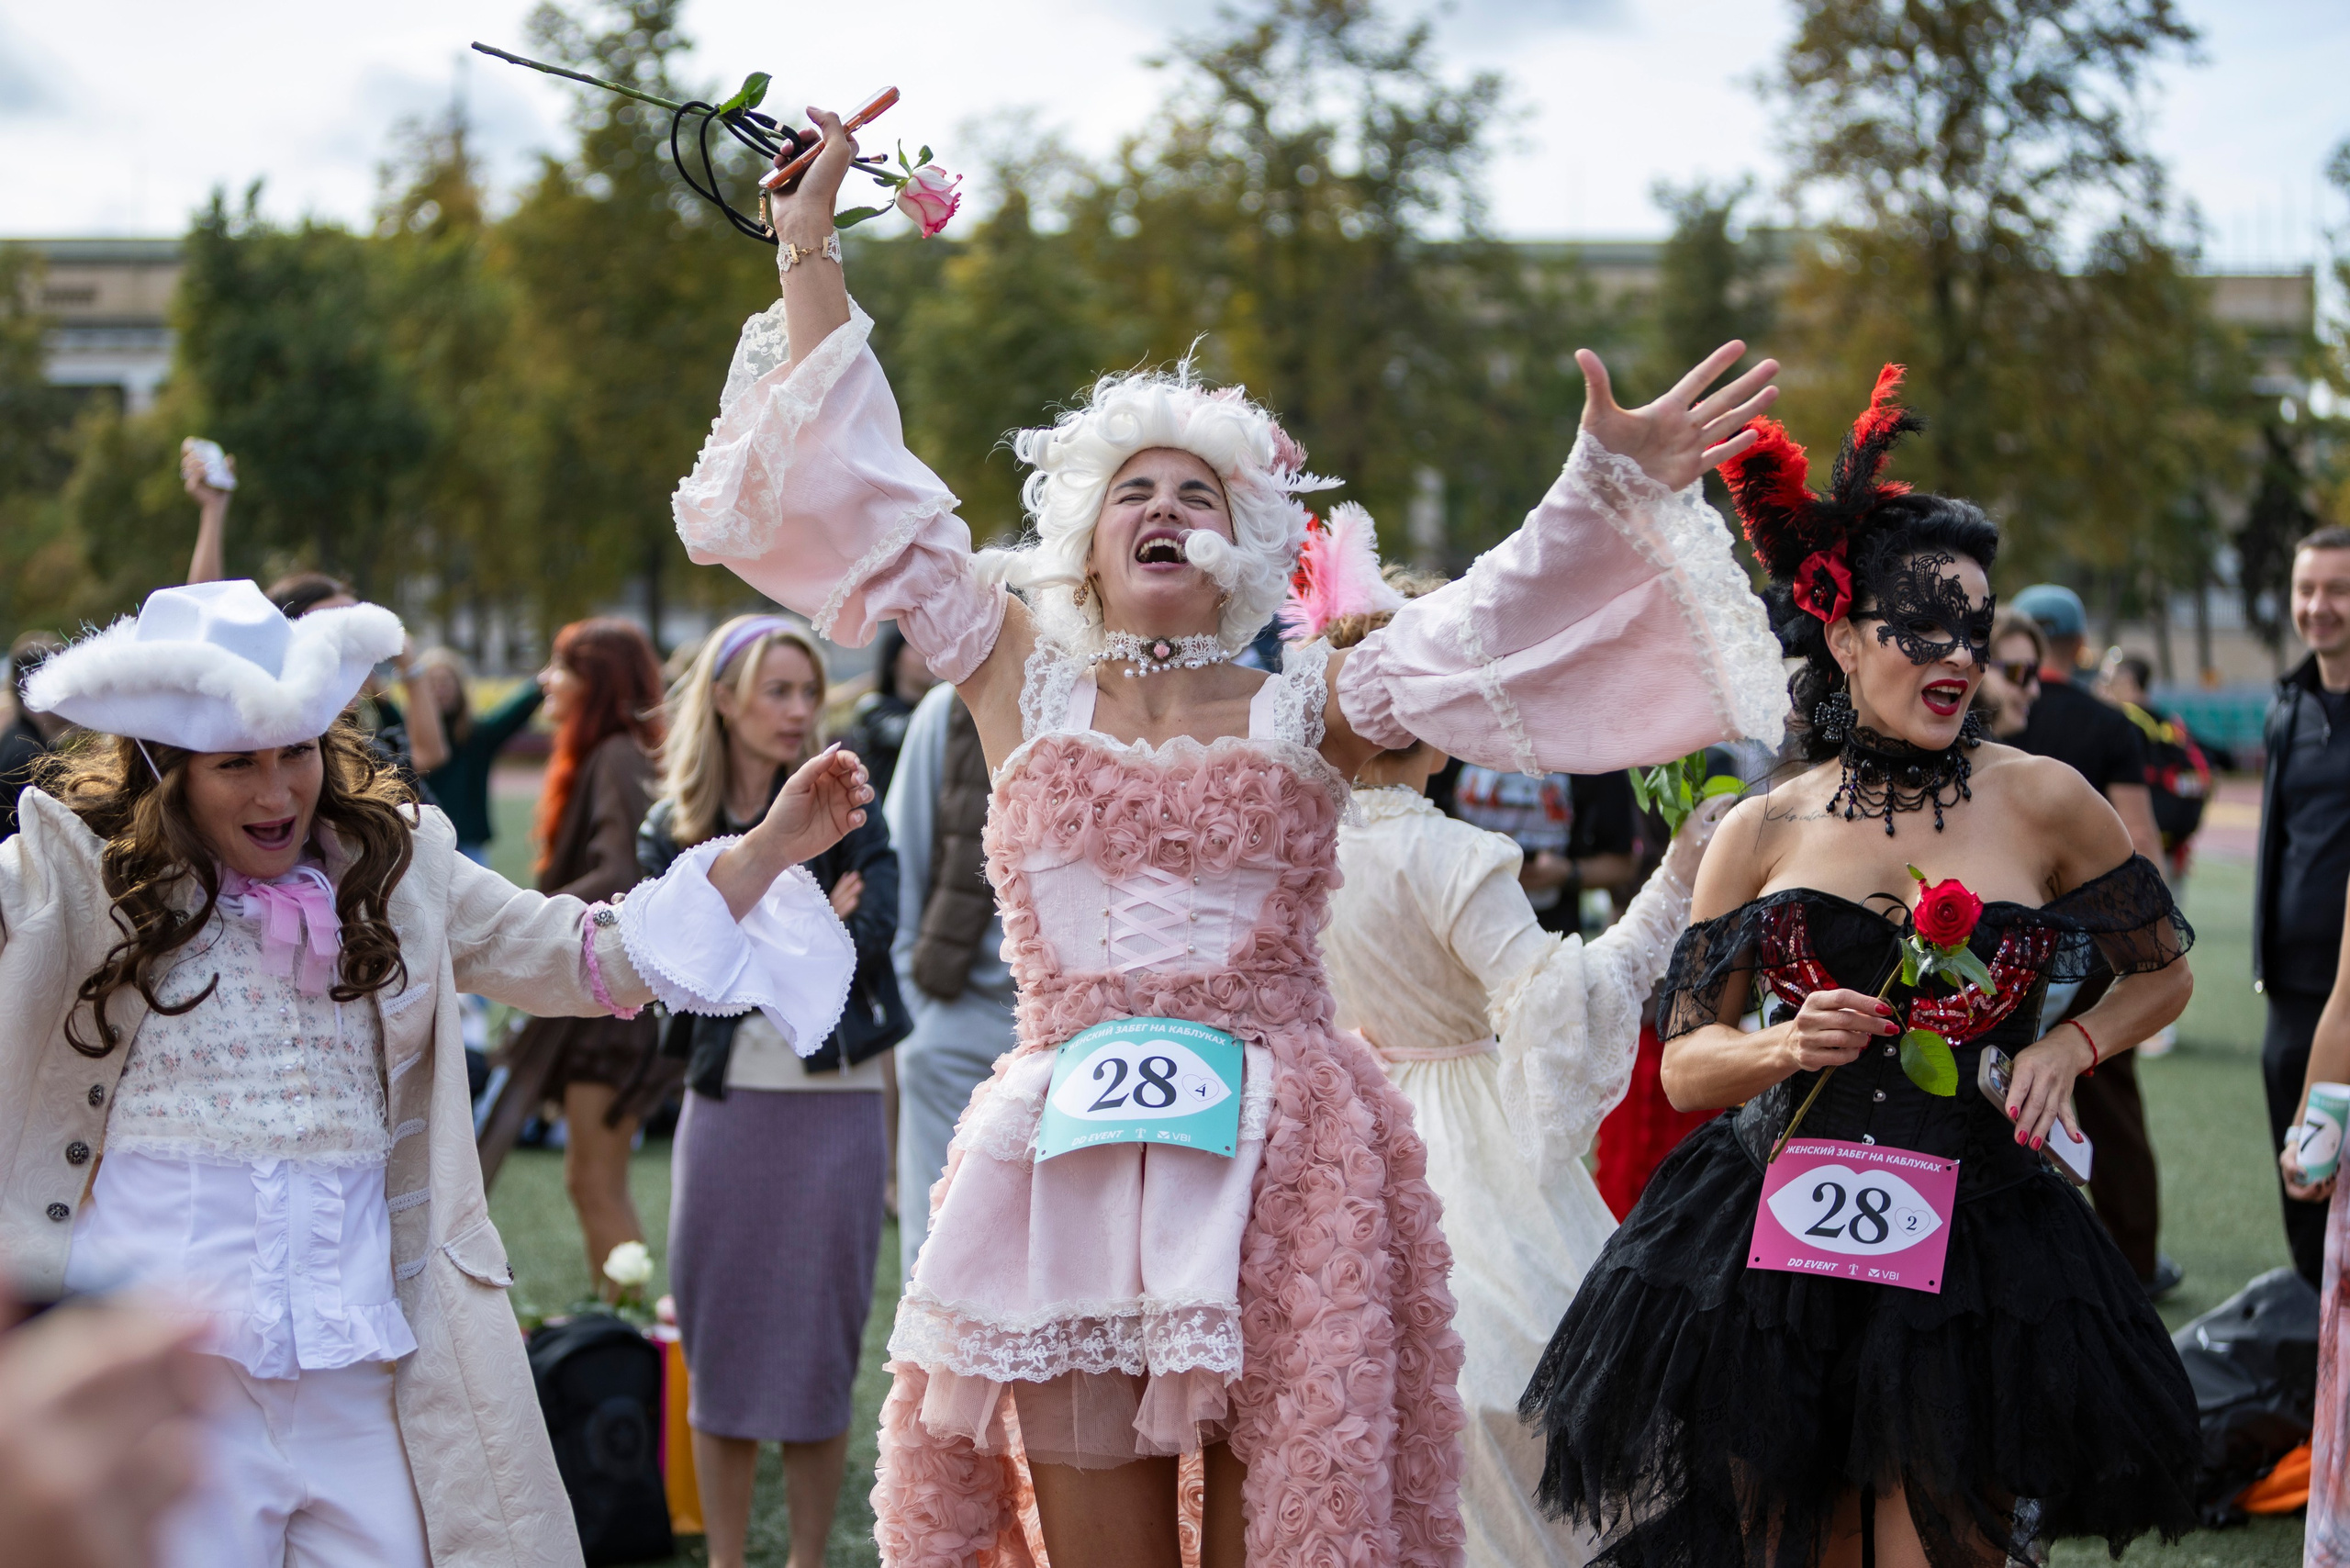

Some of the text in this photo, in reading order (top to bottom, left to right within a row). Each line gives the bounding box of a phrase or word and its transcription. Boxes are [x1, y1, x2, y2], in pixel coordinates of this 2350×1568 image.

[1068, 1024, 1226, 1052] ЖЕНСКИЙ ЗАБЕГ НА КАБЛУКАХ
[1087, 1056, 1178, 1113] 28
[1194, 1083, 1206, 1097] 4
[1071, 1130, 1124, 1147] DD EVENT
[1172, 1132, 1192, 1142] VBI
[1785, 1145, 1942, 1172] ЖЕНСКИЙ ЗАБЕГ НА КАБЛУКАХ
[1804, 1182, 1892, 1244] 28
[1906, 1215, 1918, 1231] 2
[1787, 1258, 1839, 1271] DD EVENT
[1882, 1270, 1899, 1281] VBI
